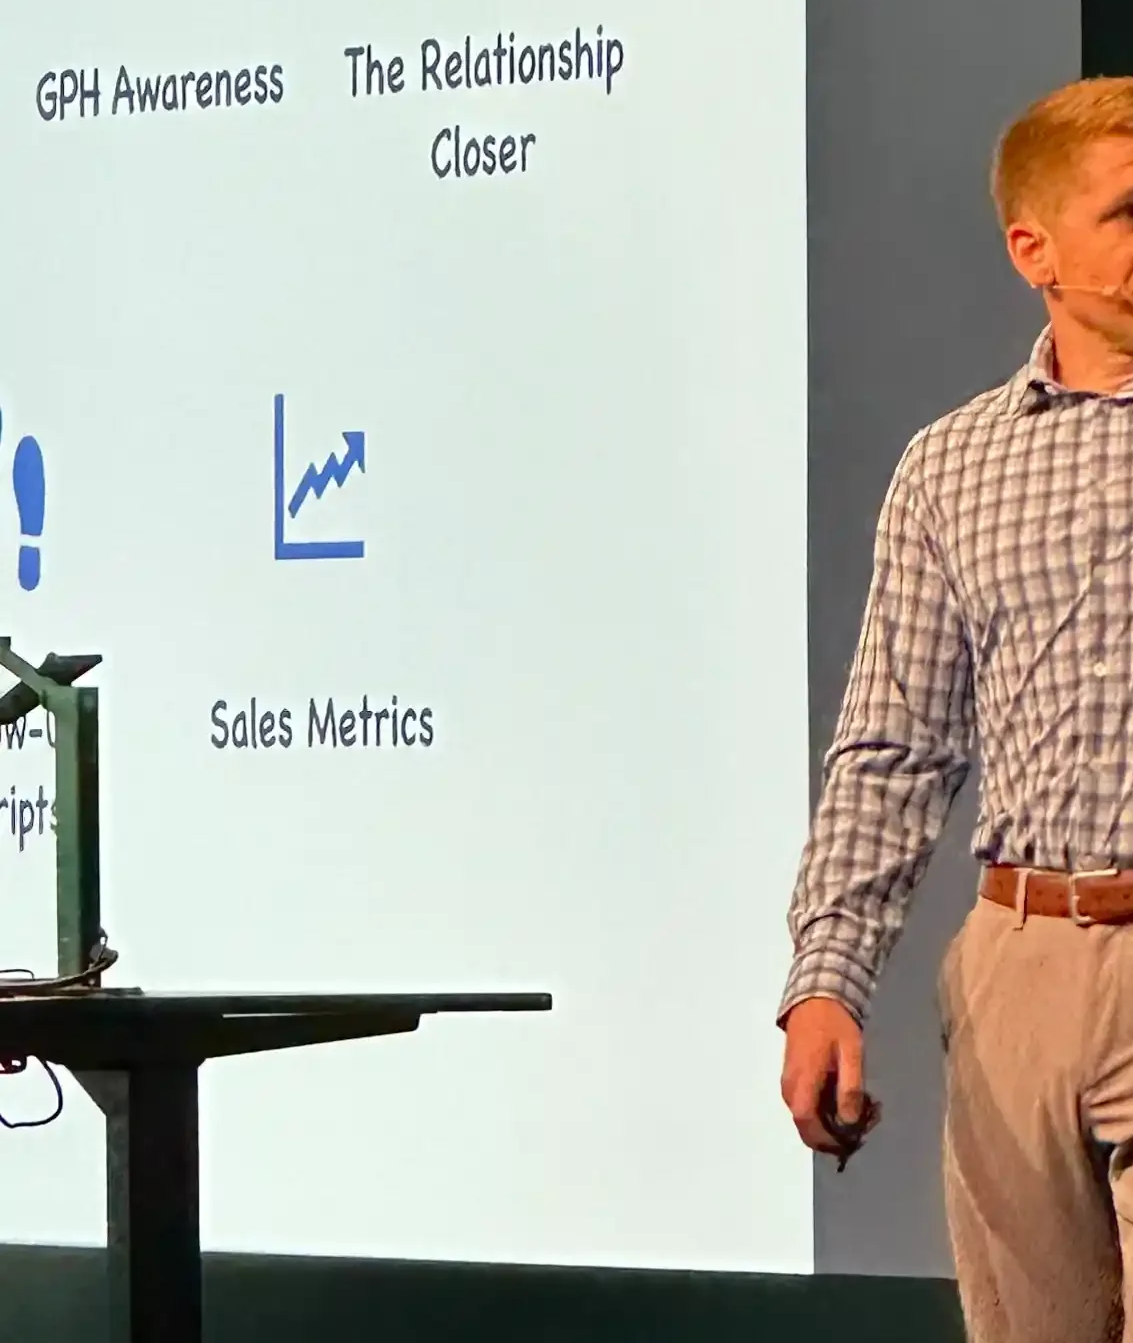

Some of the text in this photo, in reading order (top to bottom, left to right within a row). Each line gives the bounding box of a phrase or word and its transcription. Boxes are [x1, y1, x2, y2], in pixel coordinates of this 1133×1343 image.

[344, 24, 624, 98] The Relationship
[36, 64, 284, 122] GPH Awareness
[431, 124, 537, 179] Closer
[211, 694, 434, 750] Sales Metrics
